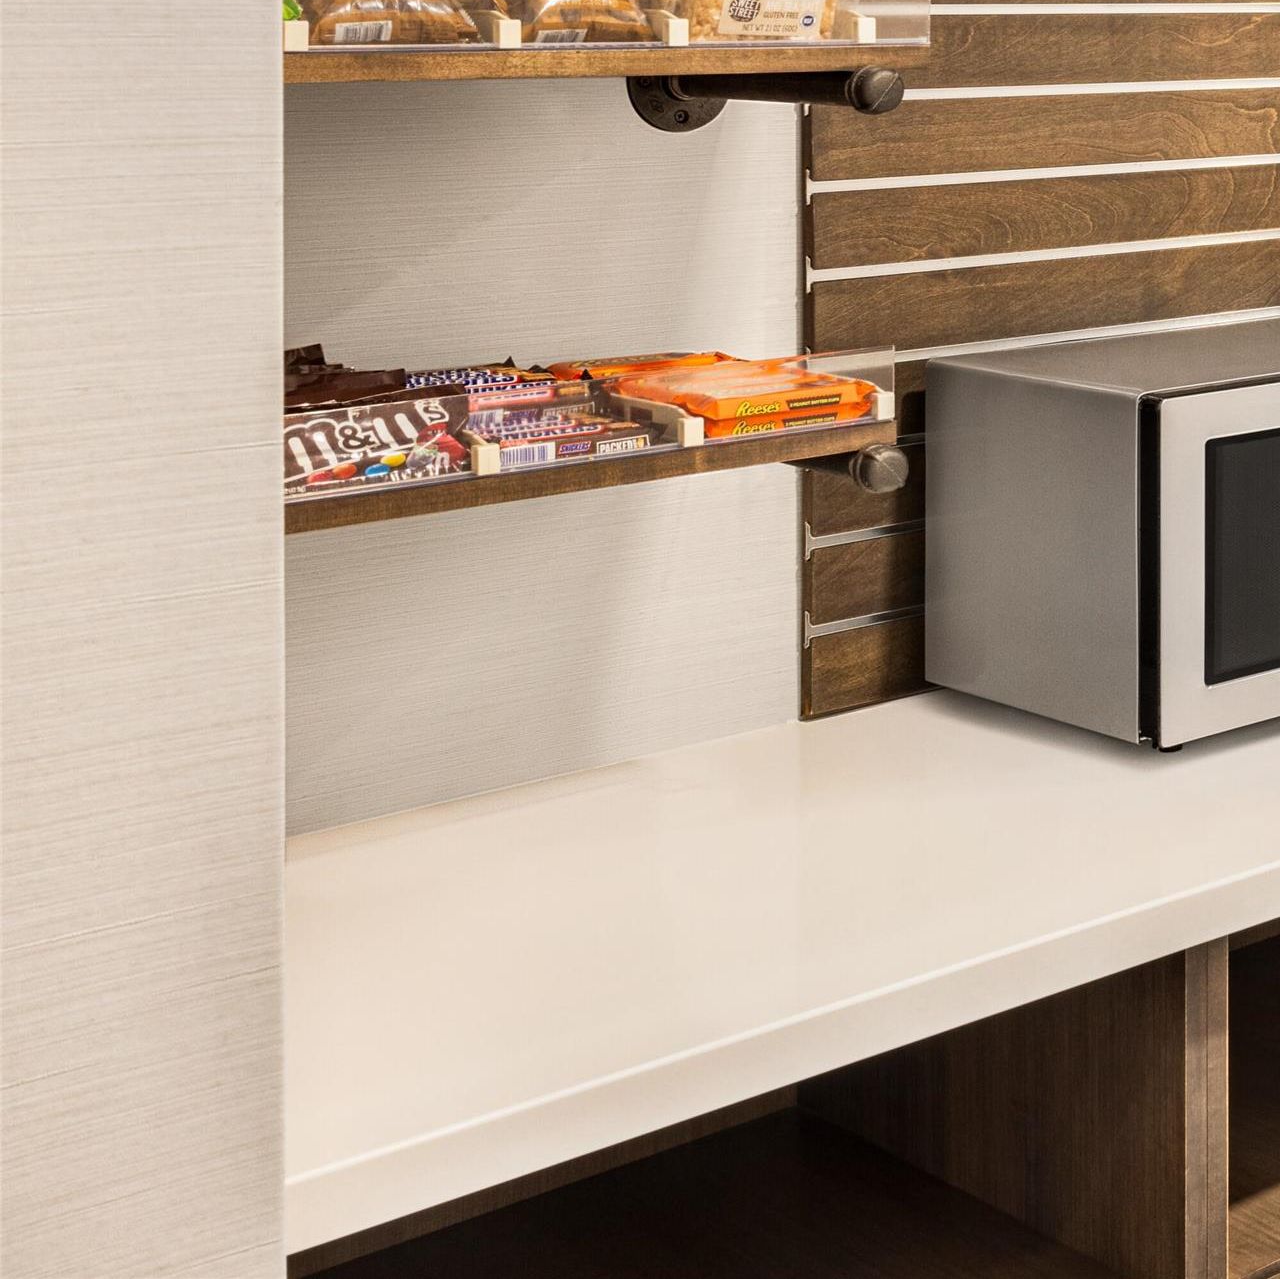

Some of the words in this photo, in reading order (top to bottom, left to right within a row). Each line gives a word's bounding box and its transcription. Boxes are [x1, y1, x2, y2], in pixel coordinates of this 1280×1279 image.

[728, 7, 759, 19] STREET
[763, 11, 784, 19] GLUTEN
[786, 11, 799, 19] FREE
[736, 401, 781, 417] Reese's
[559, 441, 592, 454] SNICKERS
